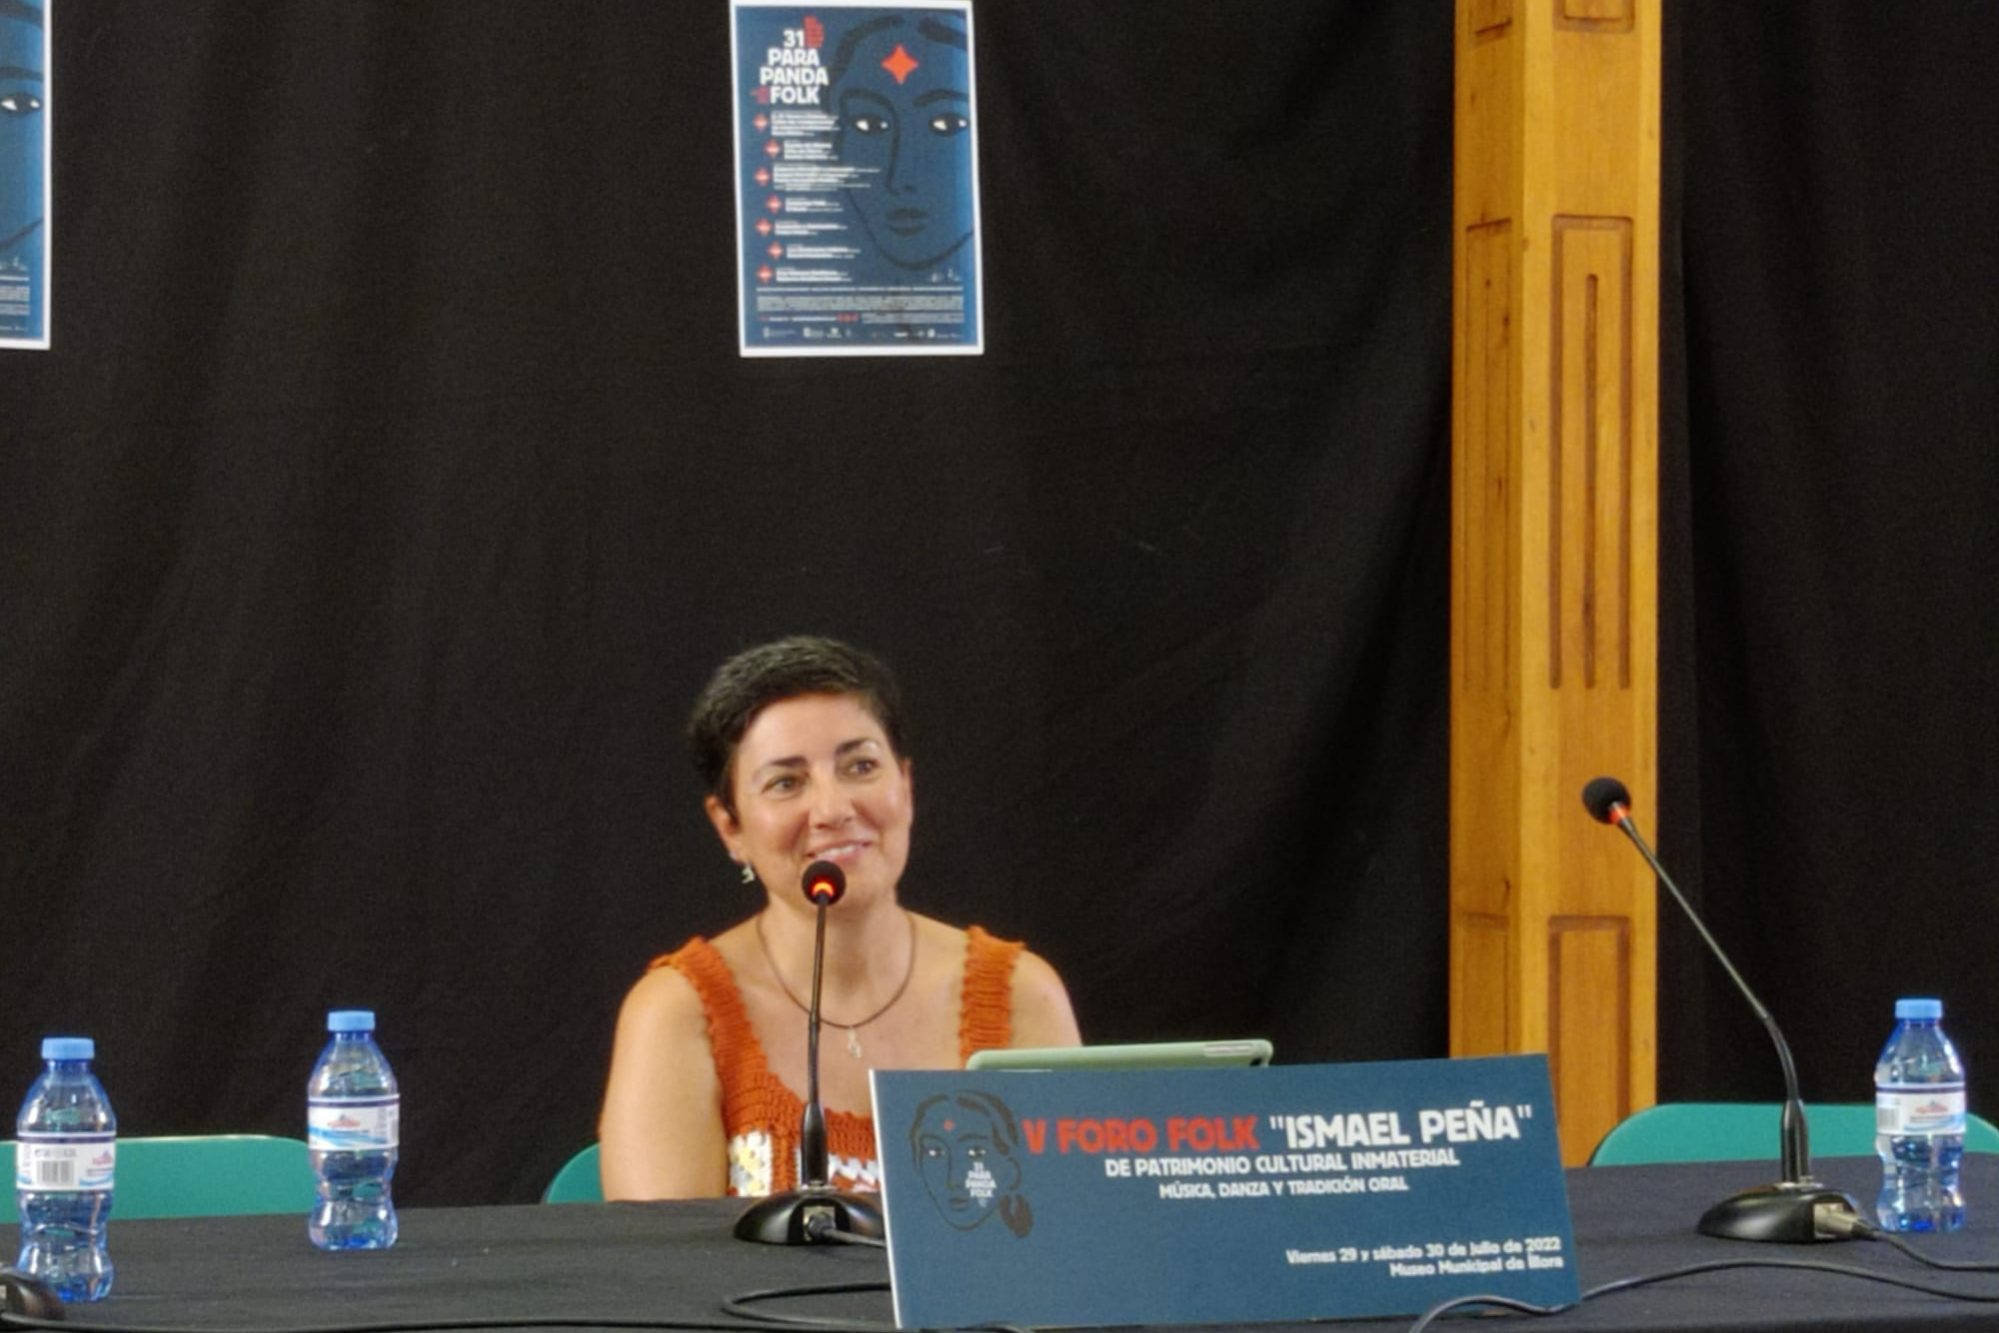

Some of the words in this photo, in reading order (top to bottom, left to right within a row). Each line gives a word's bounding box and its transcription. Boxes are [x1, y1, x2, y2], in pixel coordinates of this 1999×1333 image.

[783, 29, 804, 48] 31
[767, 48, 820, 66] PARA
[760, 67, 829, 85] PANDA
[770, 86, 820, 104] FOLK
[1023, 1117, 1047, 1154] V
[1056, 1116, 1158, 1153] FORO
[1166, 1115, 1261, 1152] FOLK
[1270, 1112, 1411, 1149] "ISMAEL
[1419, 1100, 1532, 1143] PEÑA"
[1105, 1157, 1132, 1177] DE
[1135, 1155, 1251, 1177] PATRIMONIO
[1256, 1152, 1348, 1174] CULTURAL
[1350, 1148, 1461, 1169] INMATERIAL
[1159, 1181, 1216, 1199] MÚSICA,
[1219, 1181, 1271, 1198] DANZA
[1272, 1181, 1284, 1196] Y
[1287, 1176, 1366, 1195] TRADICIÓN
[1368, 1176, 1410, 1192] ORAL
[1286, 1249, 1336, 1264] Viernes
[1338, 1247, 1358, 1262] 29
[1361, 1249, 1370, 1262] y
[1425, 1243, 1445, 1258] 30
[1448, 1241, 1467, 1257] de
[1503, 1238, 1523, 1253] de
[1524, 1236, 1562, 1252] 2022
[1389, 1262, 1436, 1277] Museo
[1438, 1258, 1503, 1275] Municipal
[1505, 1257, 1525, 1271] de
